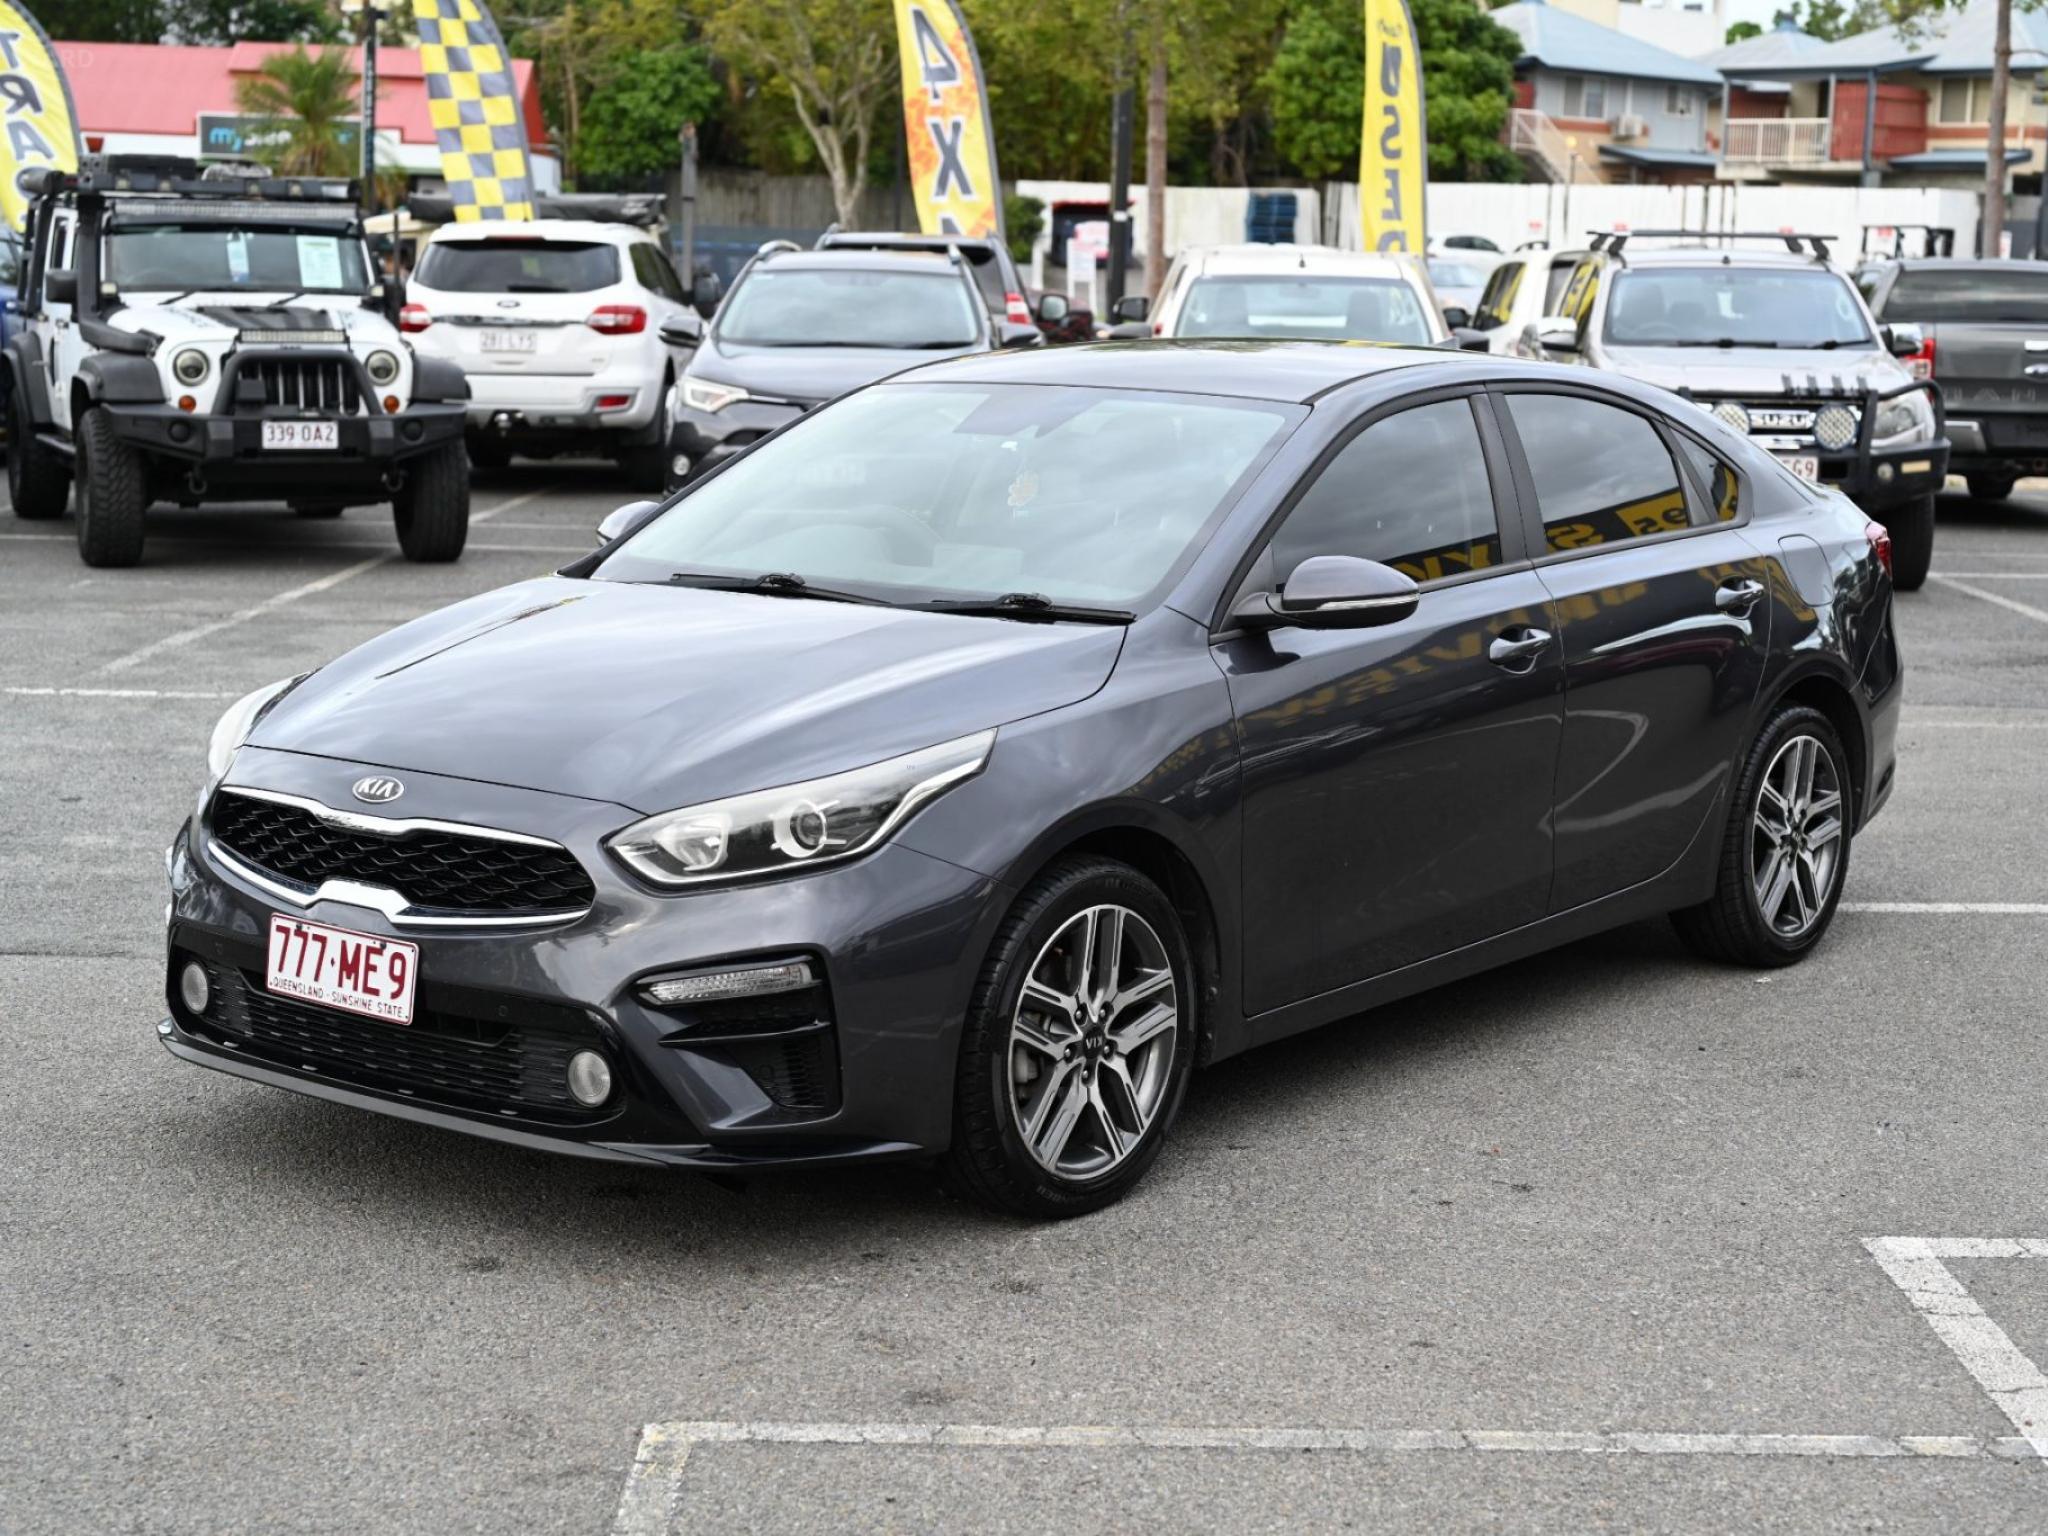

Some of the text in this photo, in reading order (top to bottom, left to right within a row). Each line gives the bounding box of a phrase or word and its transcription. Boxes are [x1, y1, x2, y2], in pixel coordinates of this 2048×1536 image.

[357, 778, 394, 798] KIA
[273, 976, 403, 1018] QUEENSLAND SUNSHINE STATE
